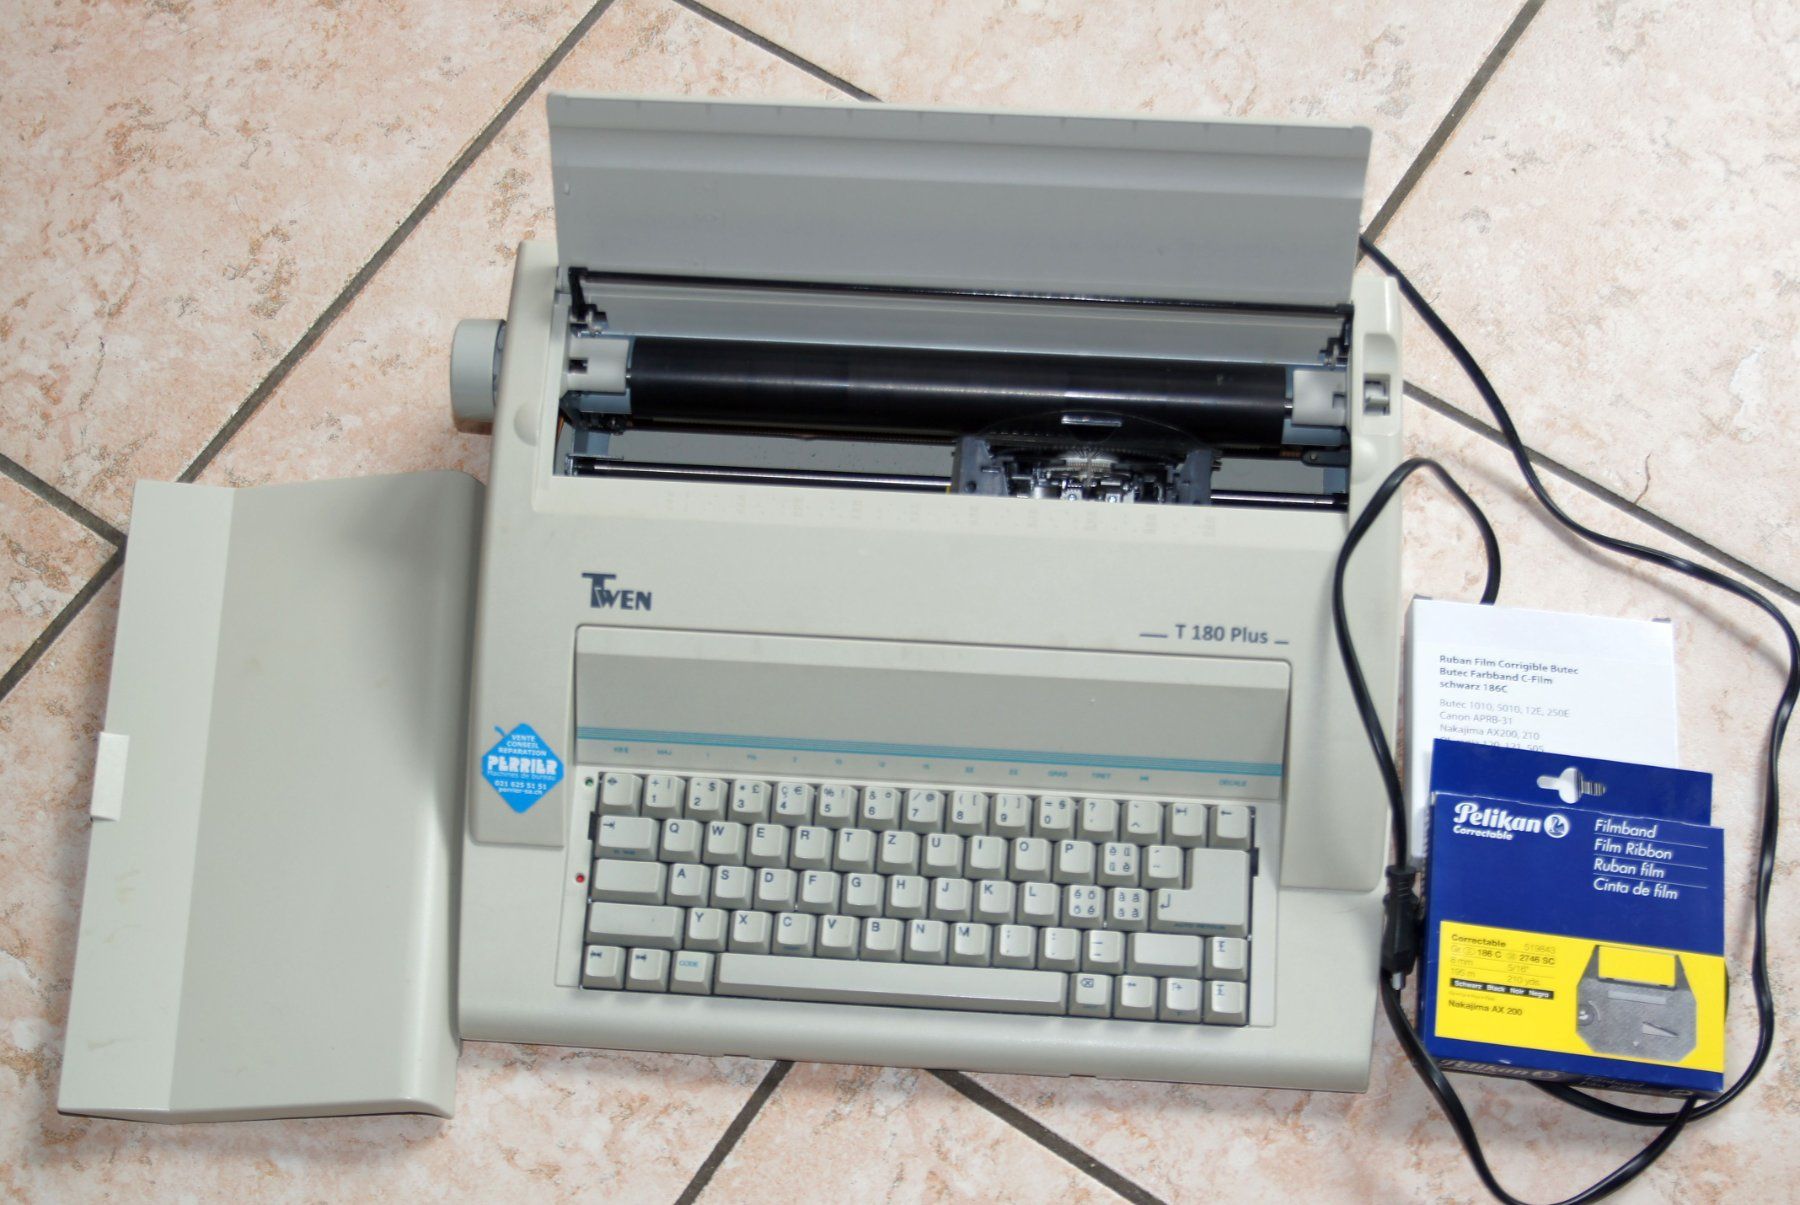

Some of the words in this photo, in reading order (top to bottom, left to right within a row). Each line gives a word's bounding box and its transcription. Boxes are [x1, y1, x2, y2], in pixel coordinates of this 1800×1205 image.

[581, 572, 652, 611] TWEN
[1175, 624, 1186, 640] T
[1192, 625, 1225, 642] 180
[1231, 627, 1268, 644] Plus
[1440, 655, 1471, 665] Ruban
[1475, 658, 1496, 668] Film
[1498, 660, 1549, 673] Corrigible
[1551, 664, 1579, 675] Butec
[1440, 668, 1467, 678] Butec
[1470, 670, 1519, 682] Farbband
[1521, 675, 1553, 685] C-Film
[1440, 680, 1480, 691] schwarz
[1484, 683, 1508, 693] 186C
[1440, 699, 1466, 709] Butec
[1440, 711, 1470, 721] Canon
[1440, 724, 1484, 736] Nakajima
[1453, 802, 1541, 834] Pelikan
[669, 823, 679, 833] Q
[712, 826, 724, 835] W
[757, 827, 765, 838] E
[1453, 825, 1513, 841] Correctable
[1595, 819, 1657, 839] Filmband
[801, 830, 809, 839] R
[845, 832, 853, 841] T
[888, 835, 896, 844] Z
[932, 838, 941, 847] U
[1020, 841, 1029, 851] O
[1065, 844, 1074, 853] P
[1594, 839, 1622, 854] Film
[1626, 842, 1672, 861] Ribbon
[678, 868, 686, 878] A
[1594, 858, 1636, 876] Ruban
[1640, 862, 1665, 879] film
[721, 869, 729, 880] S
[765, 872, 773, 882] D
[809, 875, 816, 884] F
[852, 877, 861, 887] G
[897, 880, 905, 889] H
[942, 882, 949, 892] J
[985, 885, 992, 894] K
[1029, 886, 1036, 896] L
[1593, 877, 1629, 895] Cinta
[1632, 881, 1650, 898] de
[1653, 882, 1678, 900] film
[695, 912, 704, 922] Y
[740, 915, 748, 924] X
[783, 916, 792, 927] C
[828, 919, 836, 929] V
[872, 922, 880, 932] B
[917, 924, 925, 933] N
[960, 927, 969, 936] M
[1451, 934, 1507, 948] Correctable
[1448, 999, 1490, 1012] Nakajima
[1492, 1006, 1505, 1014] AX
